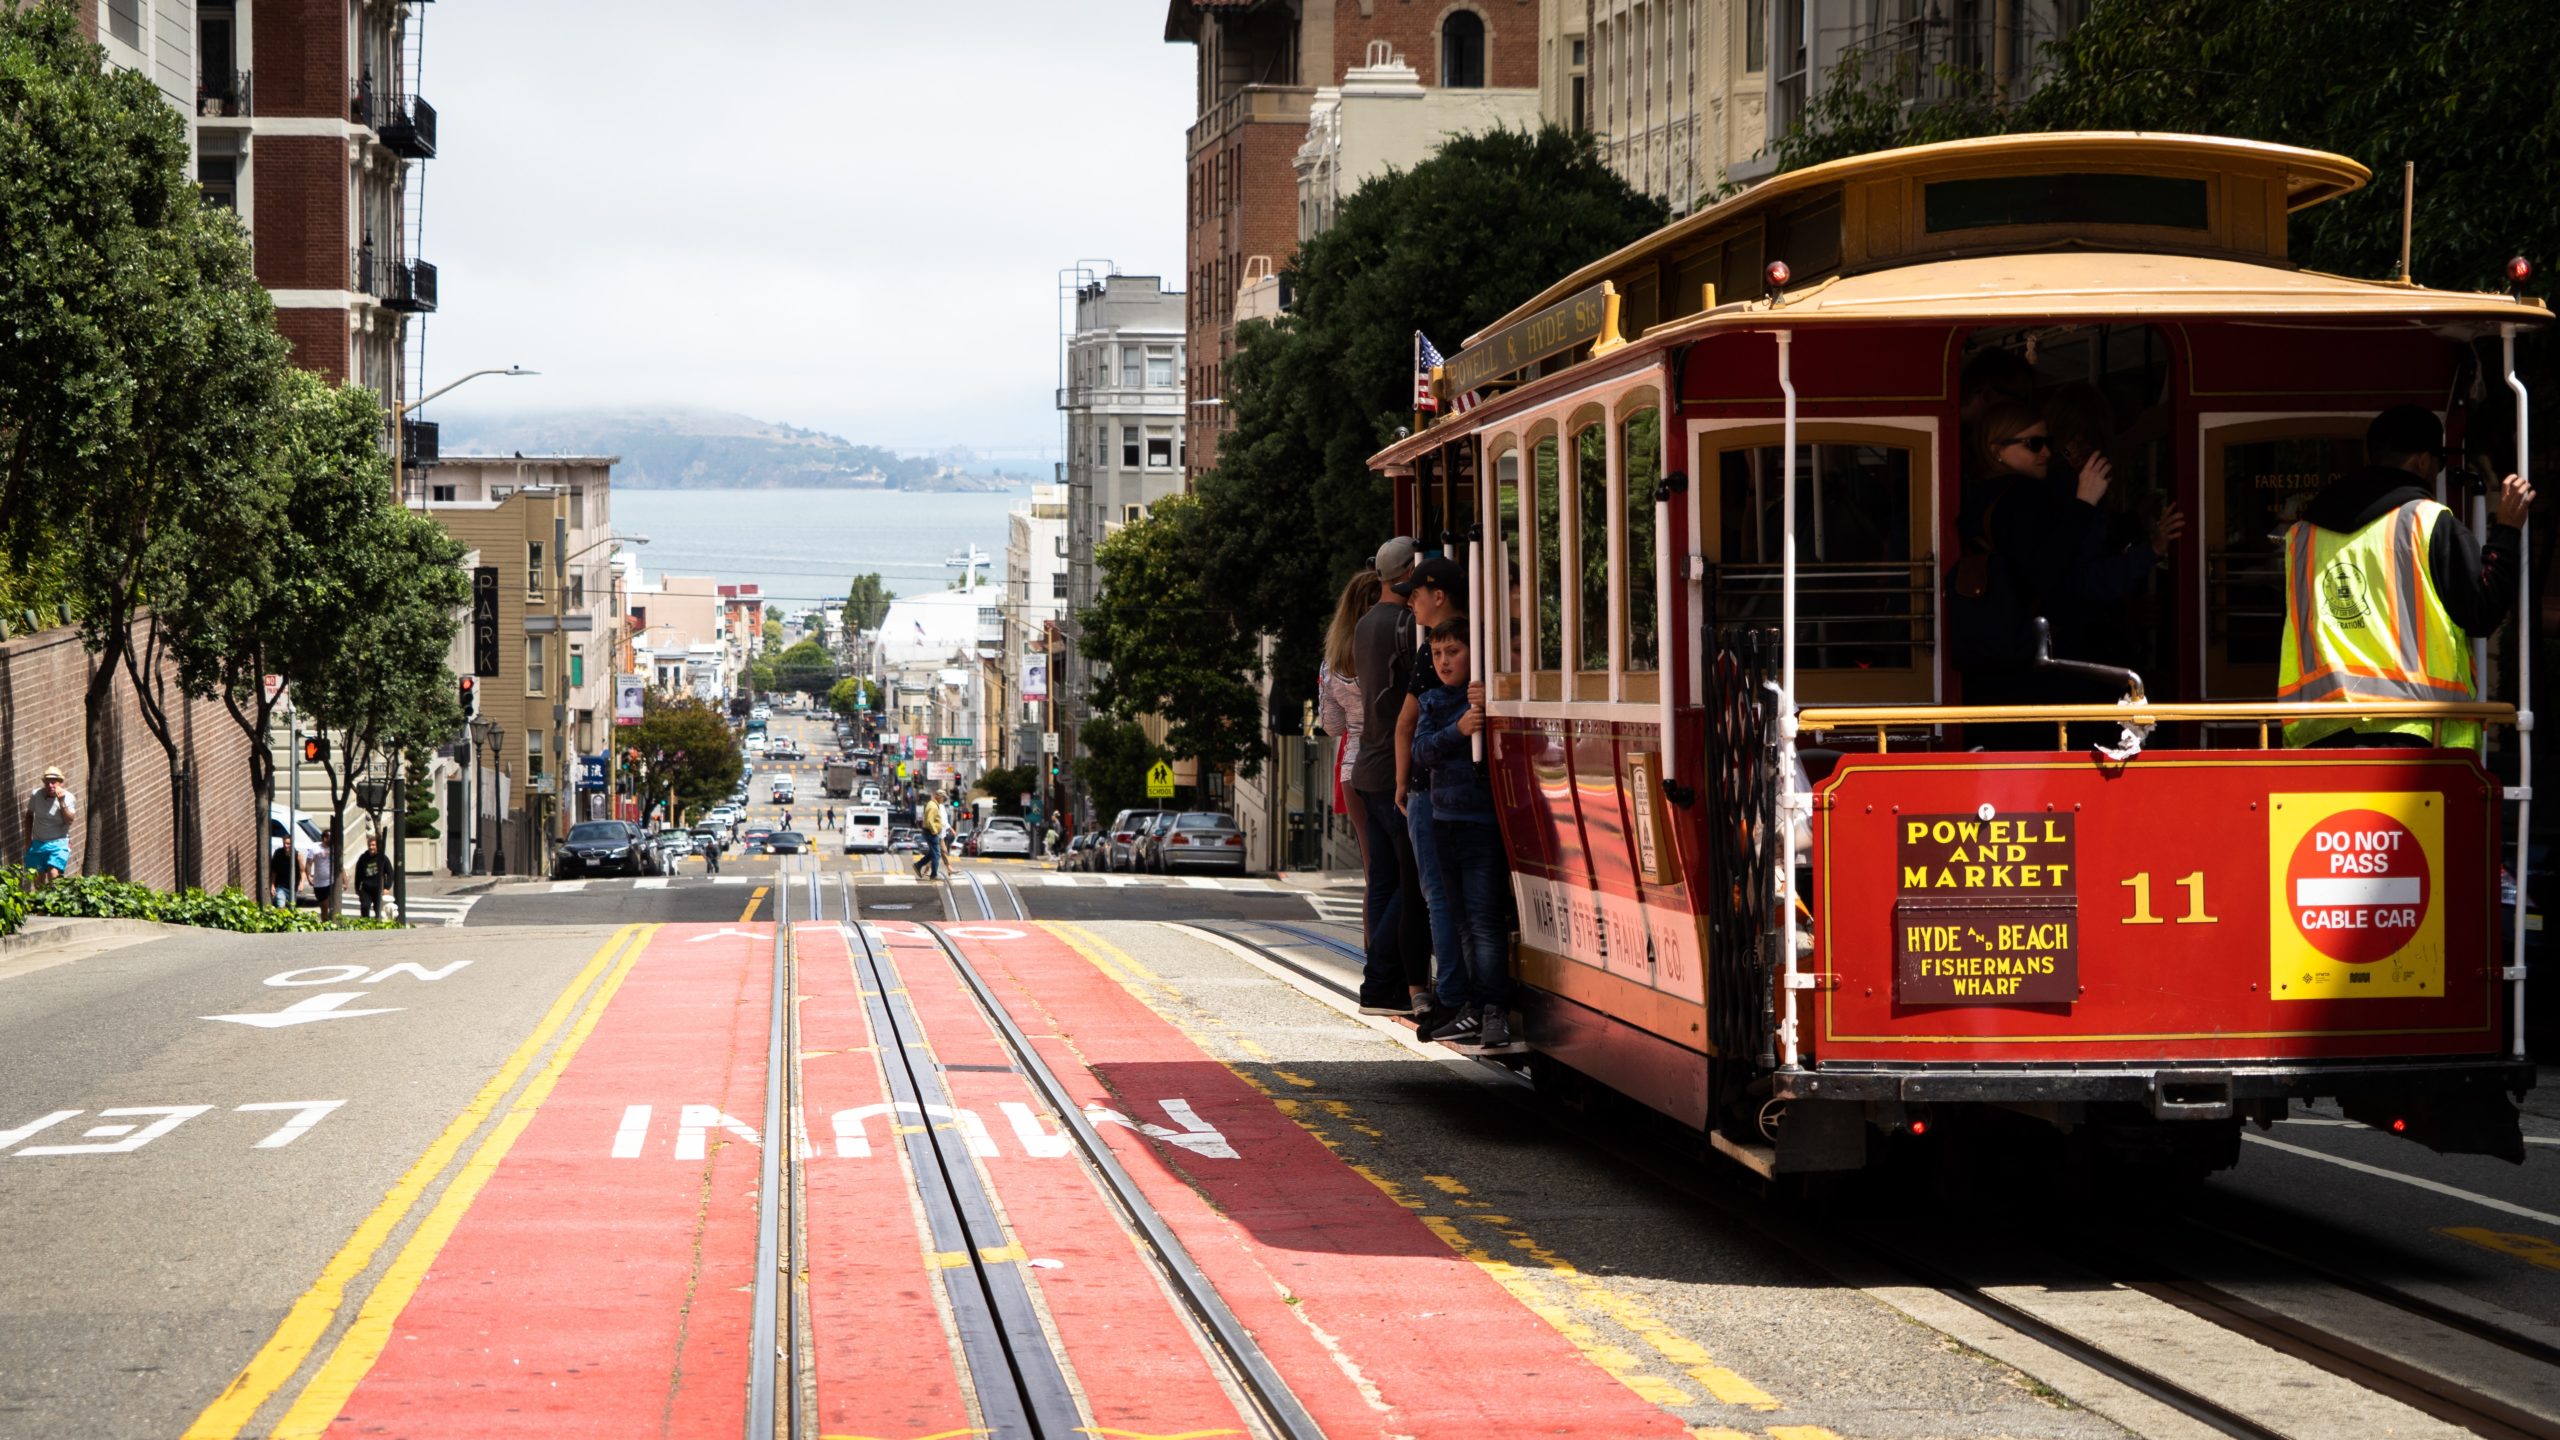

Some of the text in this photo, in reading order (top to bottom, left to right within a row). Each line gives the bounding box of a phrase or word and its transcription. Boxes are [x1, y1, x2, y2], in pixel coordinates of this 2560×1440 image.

[1447, 300, 1600, 389] POWELL & HYDE Sts.
[2254, 473, 2285, 489] FARE
[479, 574, 494, 672] PARK
[1148, 788, 1173, 797] SCHOOL
[1907, 820, 2066, 844] POWELL
[2316, 831, 2403, 852] DO NOT
[1949, 845, 2026, 863] AND
[2330, 853, 2388, 873] PASS
[1903, 864, 2069, 888] MARKET
[2120, 870, 2219, 925] 11
[2301, 909, 2416, 929] CABLE CAR
[1907, 924, 2068, 952] HYDE AND BEACH
[263, 960, 474, 987] NO
[1921, 957, 2055, 976] FISHERMANS
[1953, 977, 2022, 996] WHARF
[610, 1098, 1242, 1161] MUNI
